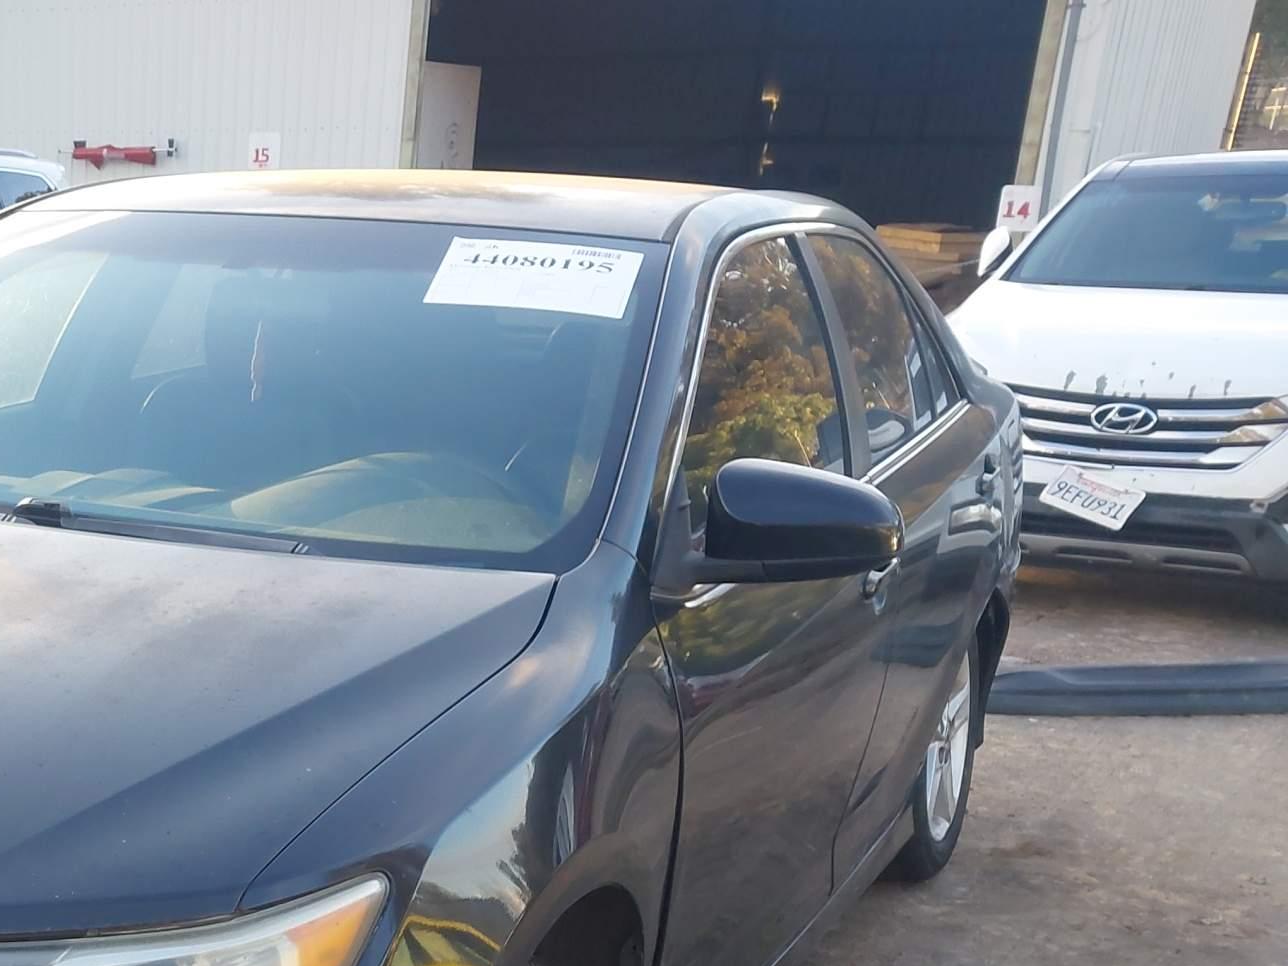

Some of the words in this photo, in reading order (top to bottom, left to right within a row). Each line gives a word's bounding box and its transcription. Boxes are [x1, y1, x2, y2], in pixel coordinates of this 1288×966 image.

[253, 147, 270, 163] 15
[1002, 200, 1032, 219] 14
[463, 252, 616, 274] 44080195
[1047, 480, 1126, 520] 9EFU931
